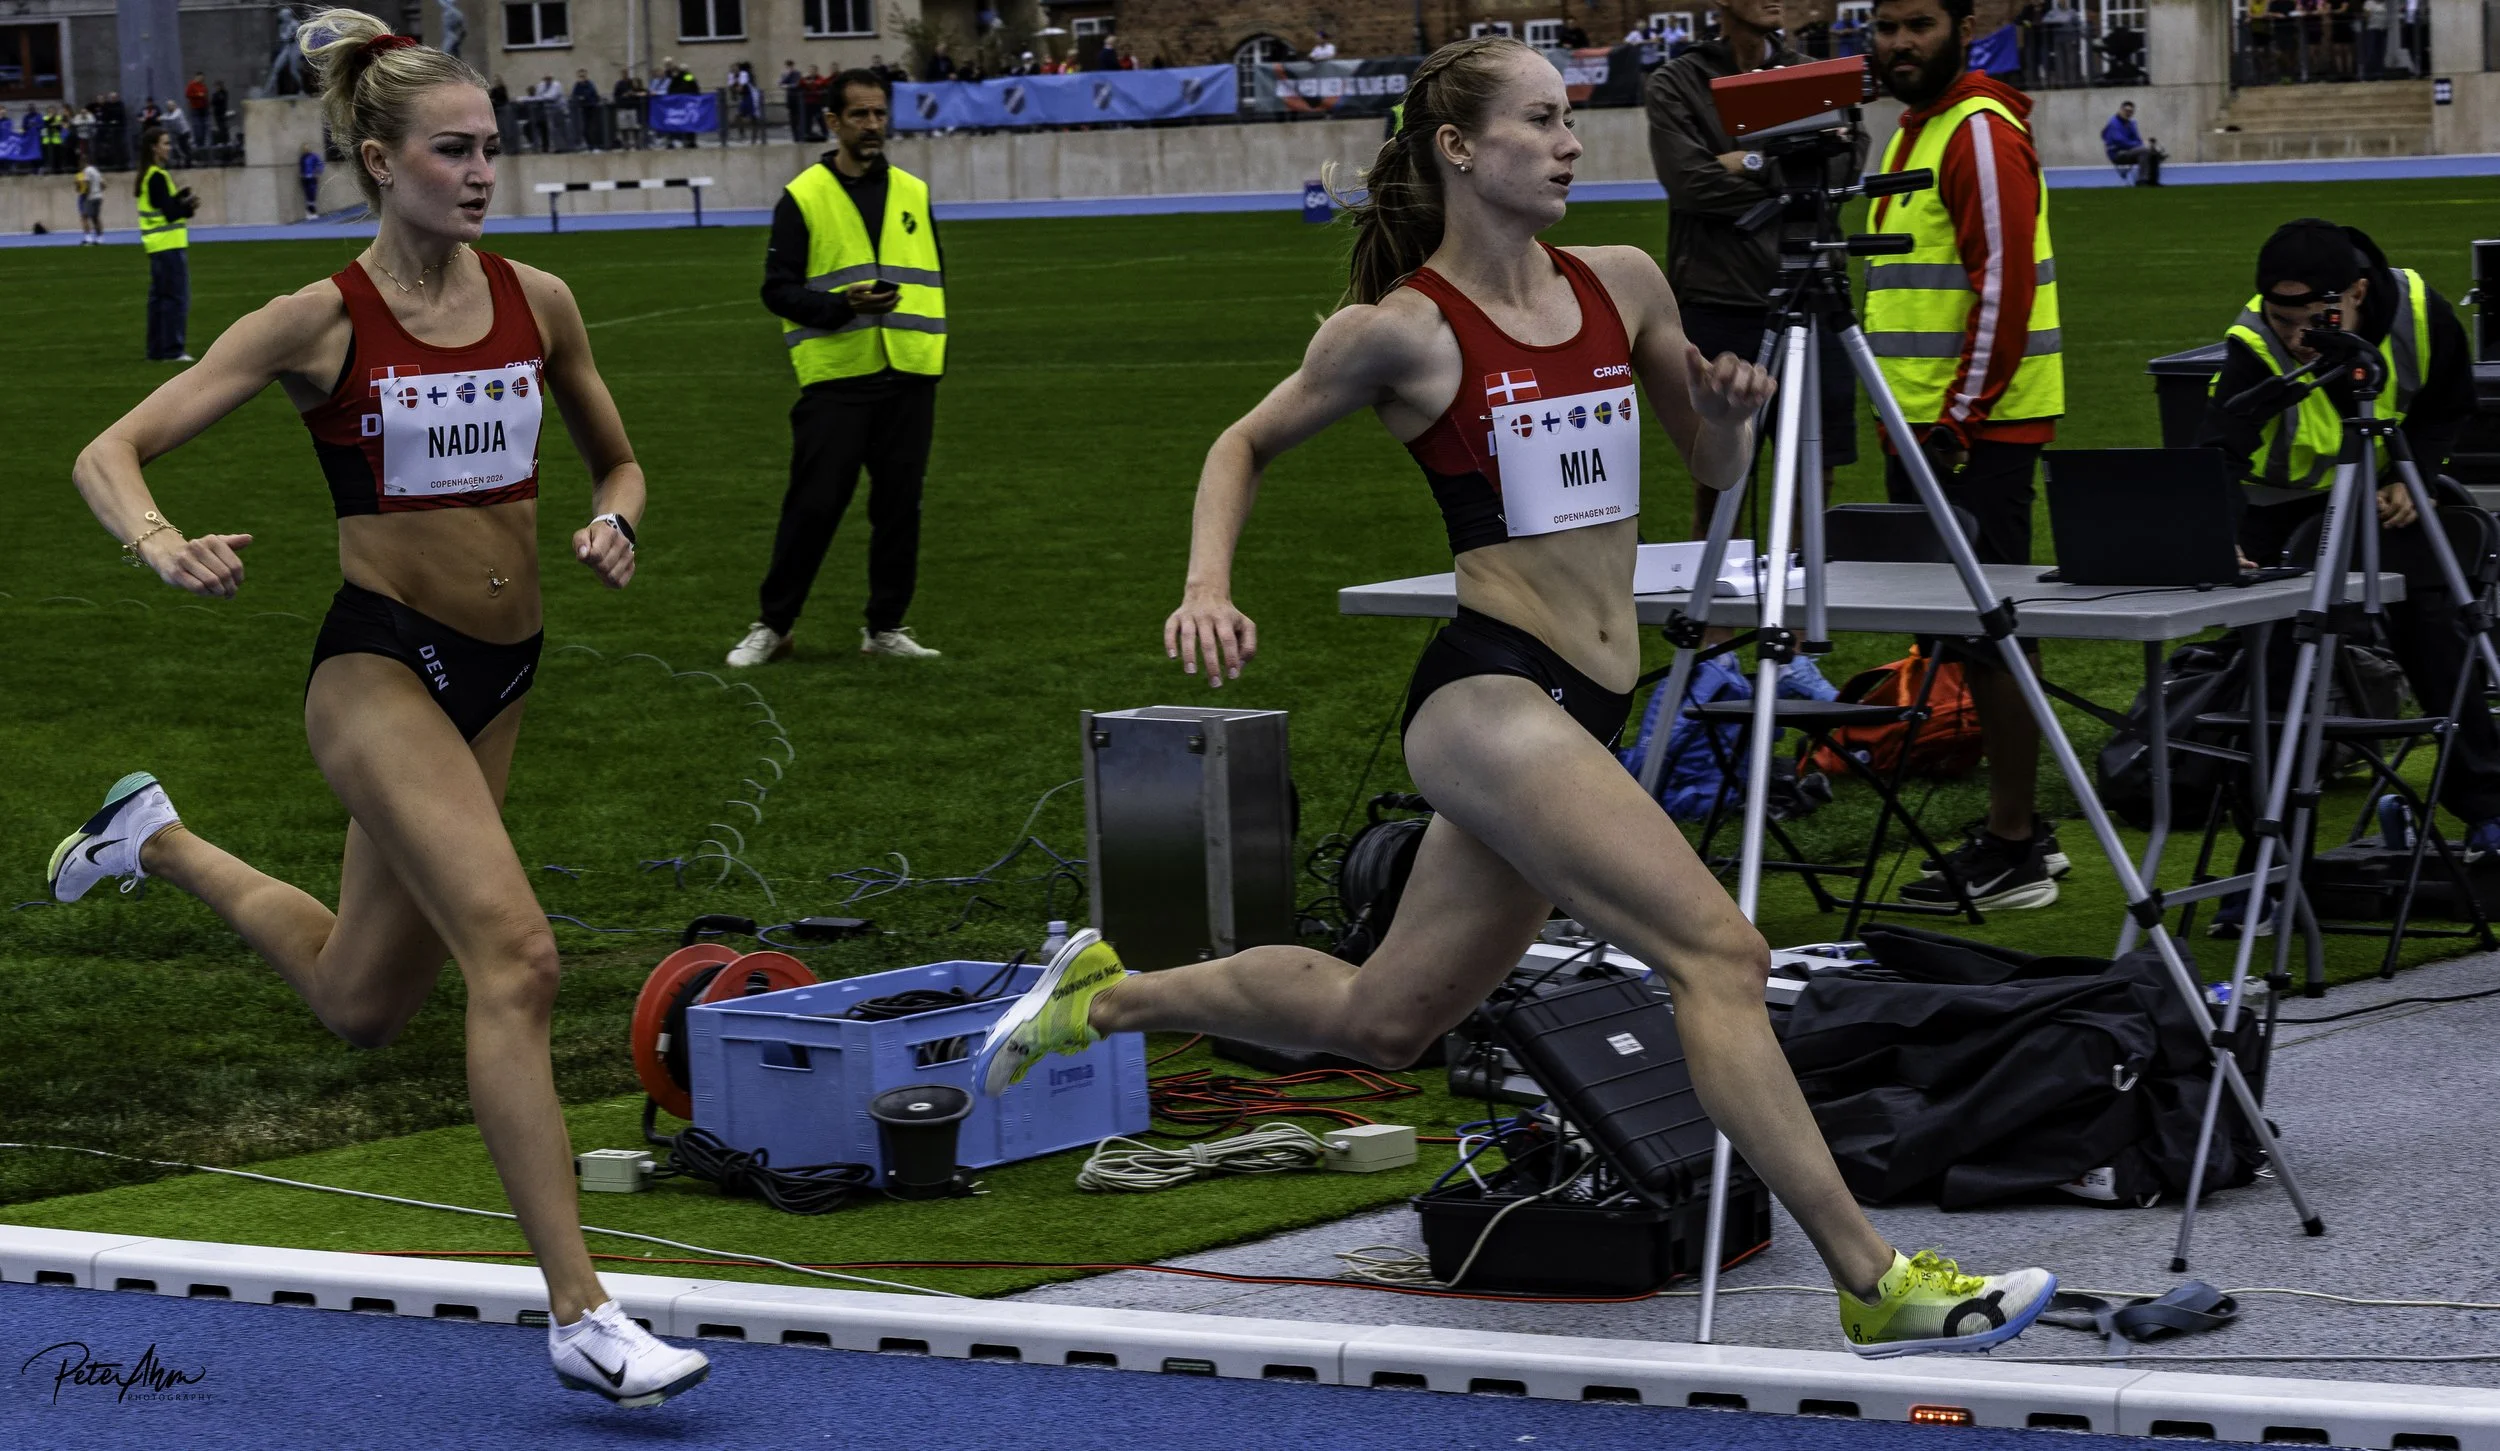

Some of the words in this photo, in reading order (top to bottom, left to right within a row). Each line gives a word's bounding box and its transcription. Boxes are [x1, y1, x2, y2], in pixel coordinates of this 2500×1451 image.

[1593, 365, 1627, 378] CRAFT
[428, 420, 507, 458] NADJA
[430, 476, 485, 489] COPENHAGEN
[486, 473, 504, 484] 2026
[1560, 448, 1607, 488] MIA
[1553, 507, 1604, 524] COPENHAGEN
[1605, 505, 1621, 516] 2026
[419, 644, 450, 691] DEN
